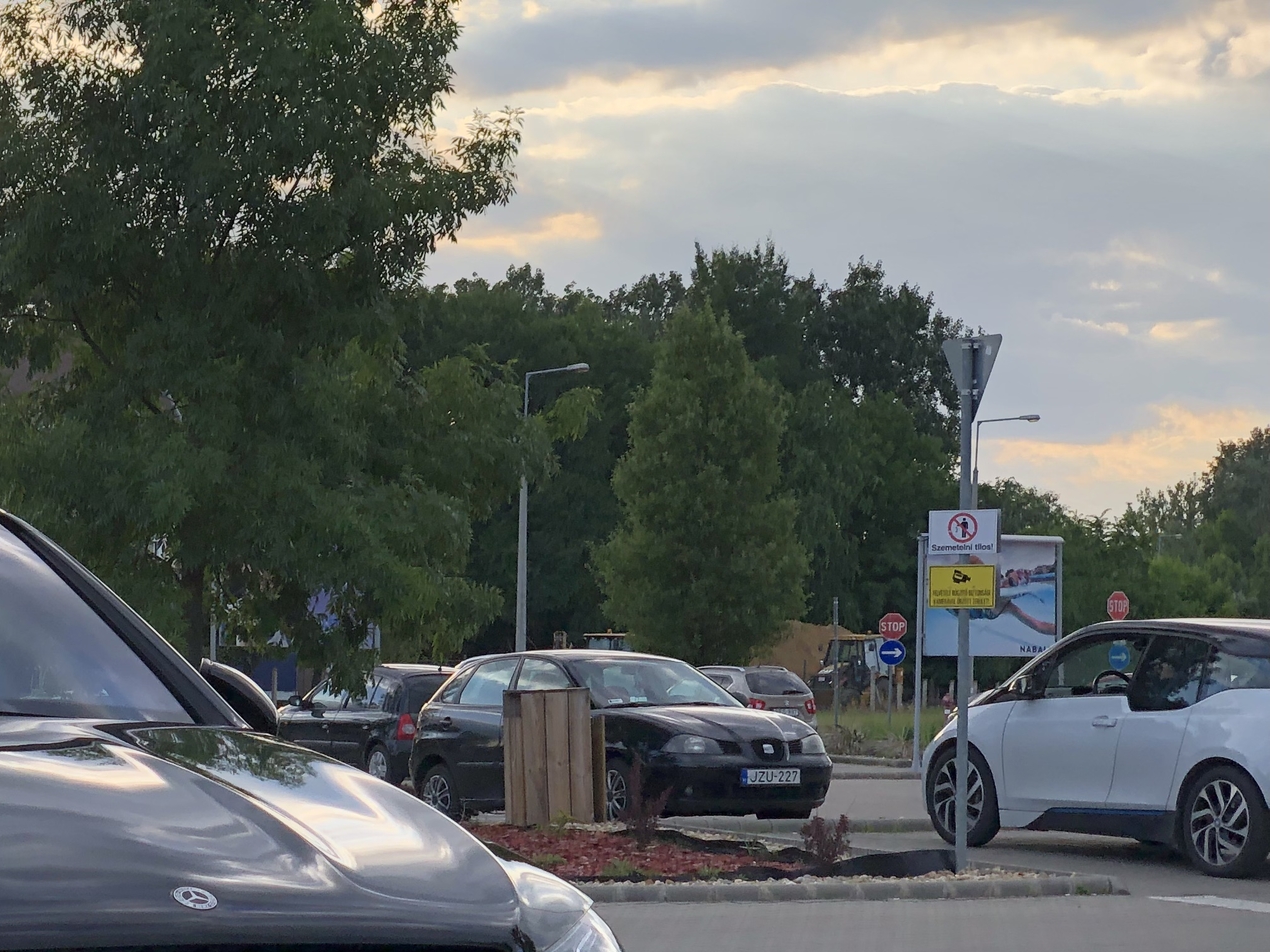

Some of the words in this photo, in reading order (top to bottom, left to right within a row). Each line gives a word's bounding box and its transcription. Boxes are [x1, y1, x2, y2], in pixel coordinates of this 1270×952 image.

[931, 544, 973, 552] Szemetelni
[974, 543, 994, 551] tilos!
[1109, 600, 1128, 612] STOP
[881, 622, 905, 632] STOP
[750, 770, 798, 783] JZU-227
